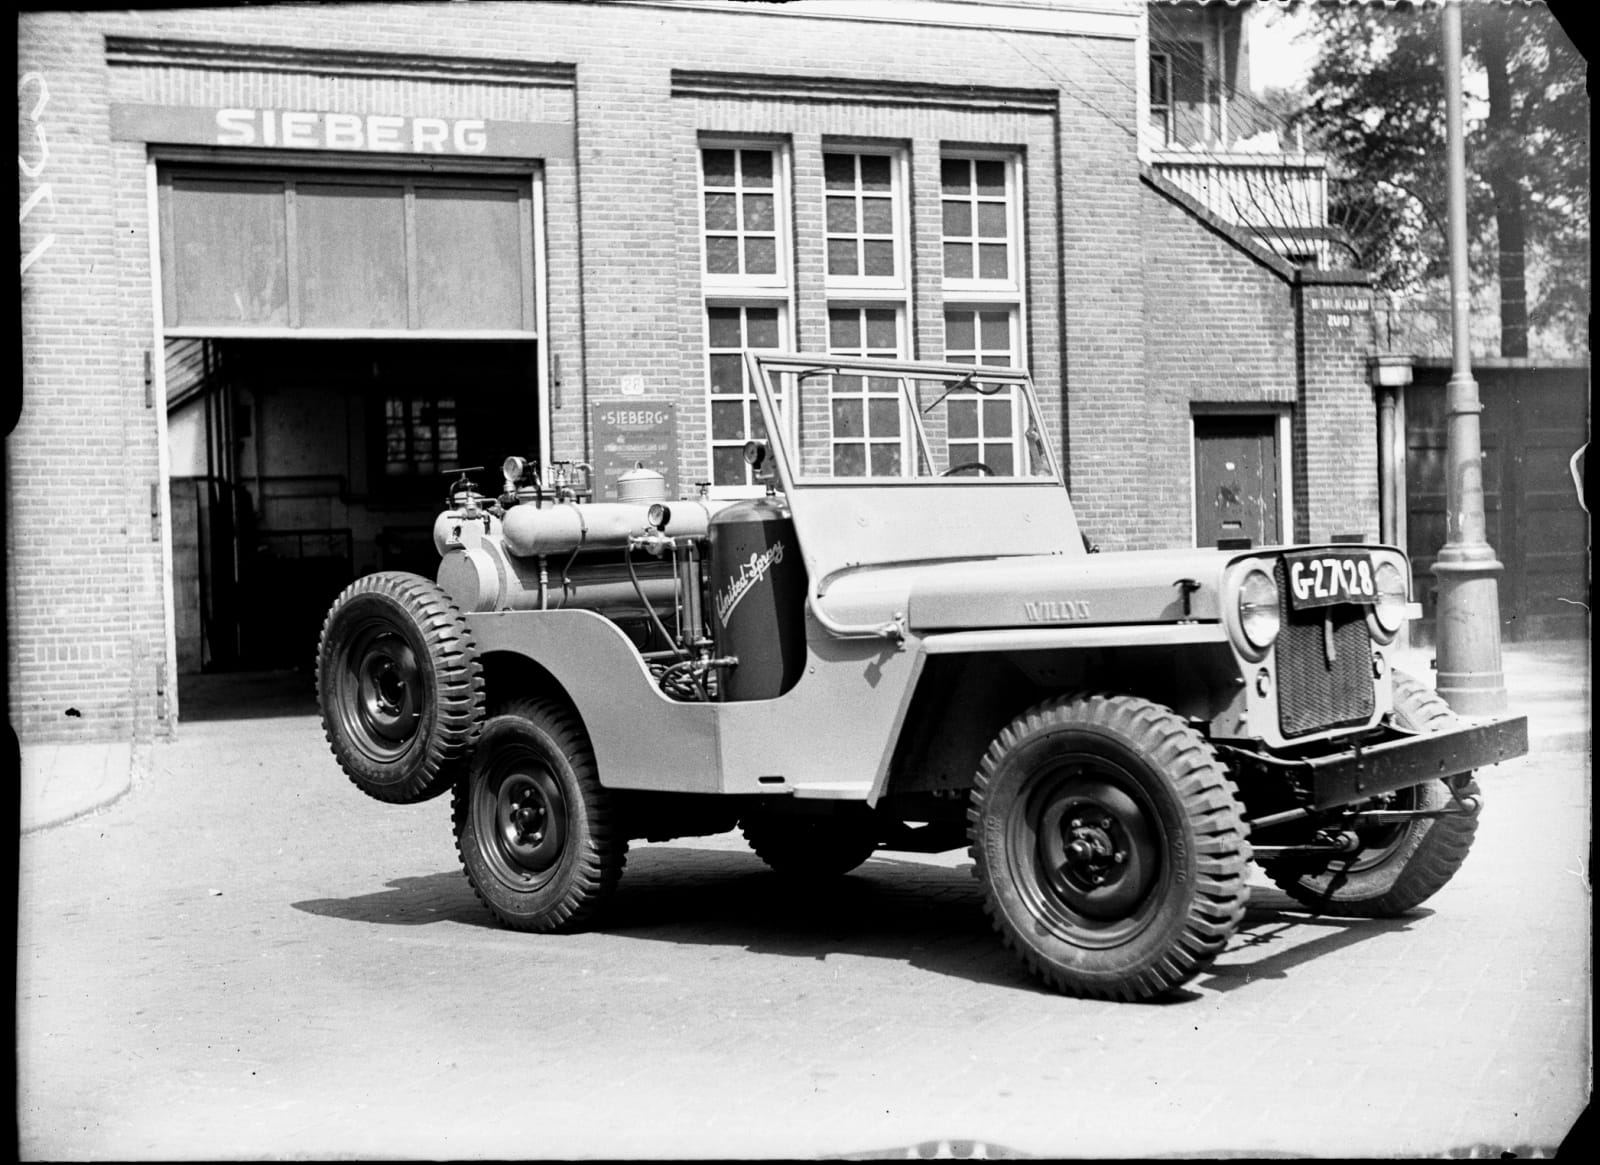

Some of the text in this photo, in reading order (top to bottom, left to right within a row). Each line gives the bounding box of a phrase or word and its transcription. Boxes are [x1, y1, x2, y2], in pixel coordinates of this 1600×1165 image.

[215, 108, 487, 154] SIEBERG
[607, 411, 664, 425] SIEBERG
[1023, 601, 1090, 621] WILLYS
